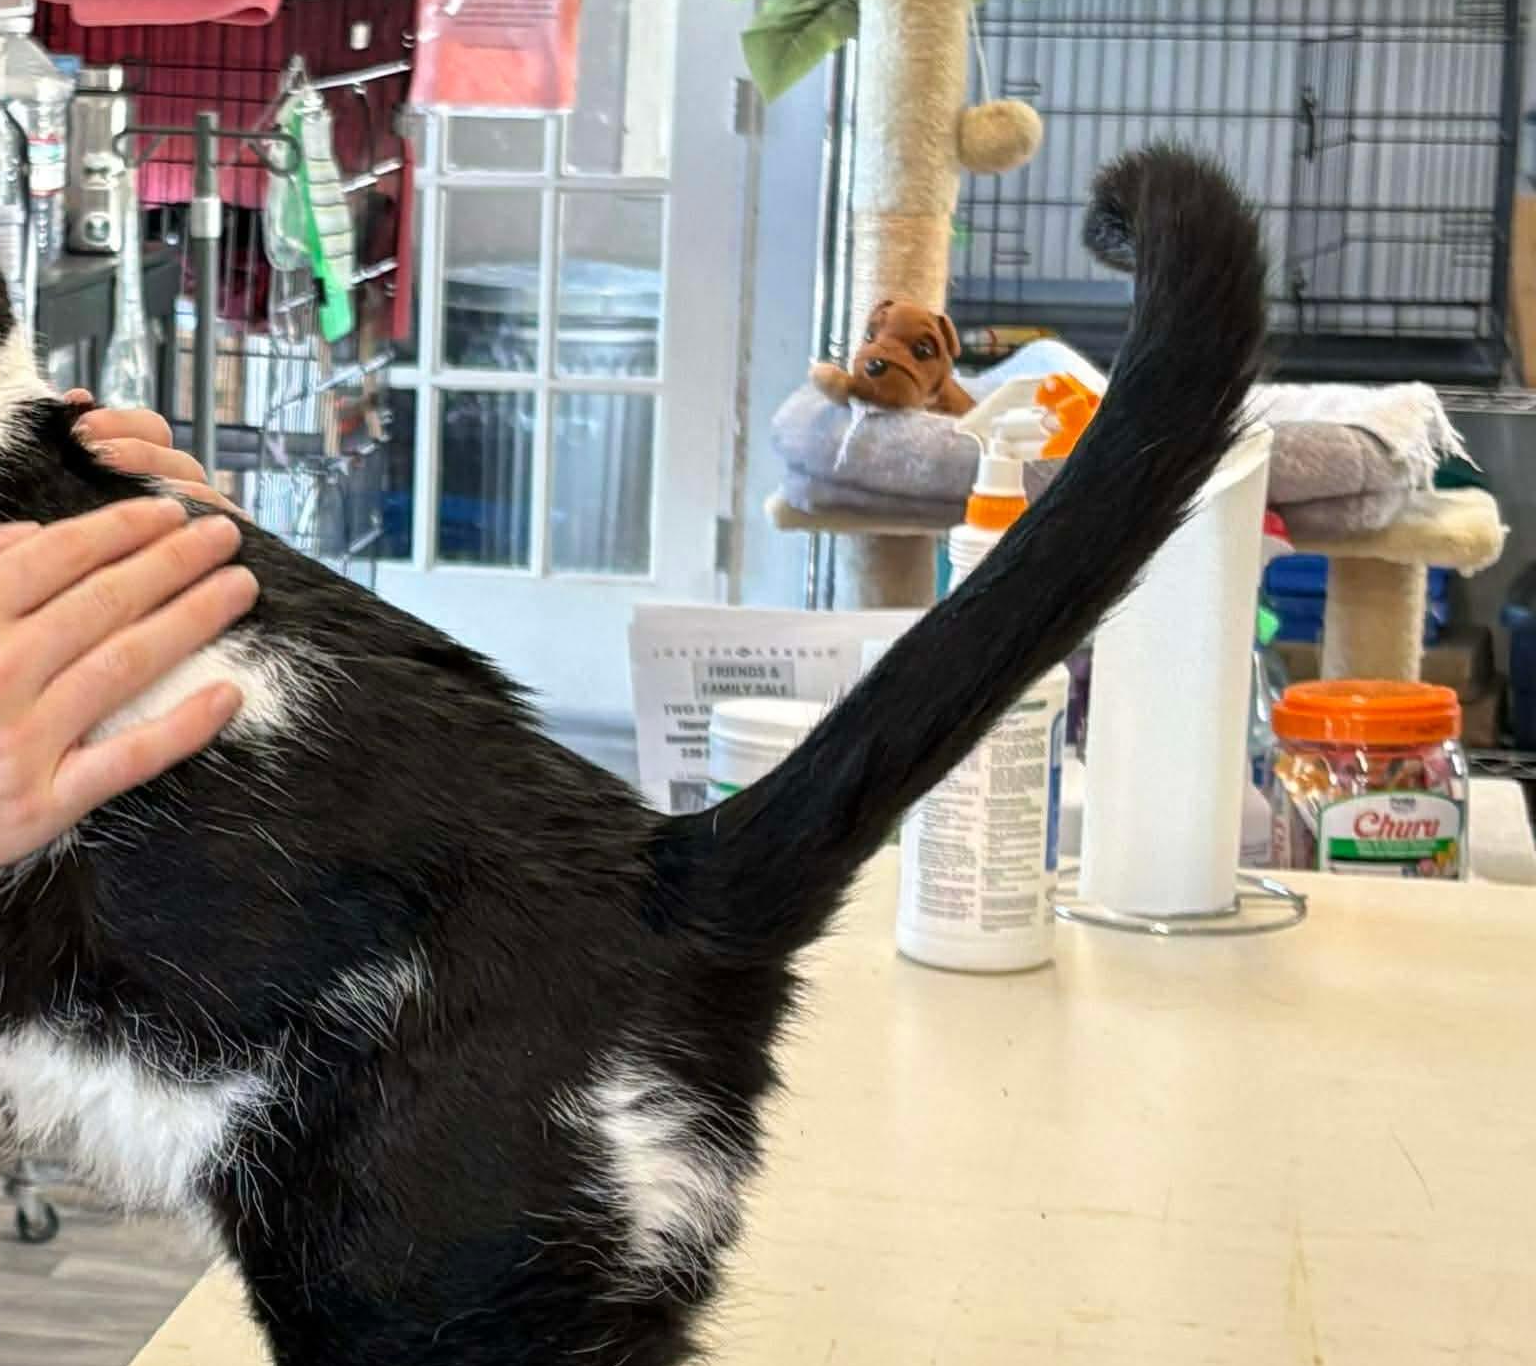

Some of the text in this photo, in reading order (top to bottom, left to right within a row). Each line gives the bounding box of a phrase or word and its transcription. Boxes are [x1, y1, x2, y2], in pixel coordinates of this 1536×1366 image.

[707, 666, 767, 679] FRIENDS
[701, 683, 789, 696] FAMILY SALE
[1353, 810, 1441, 839] Churu
